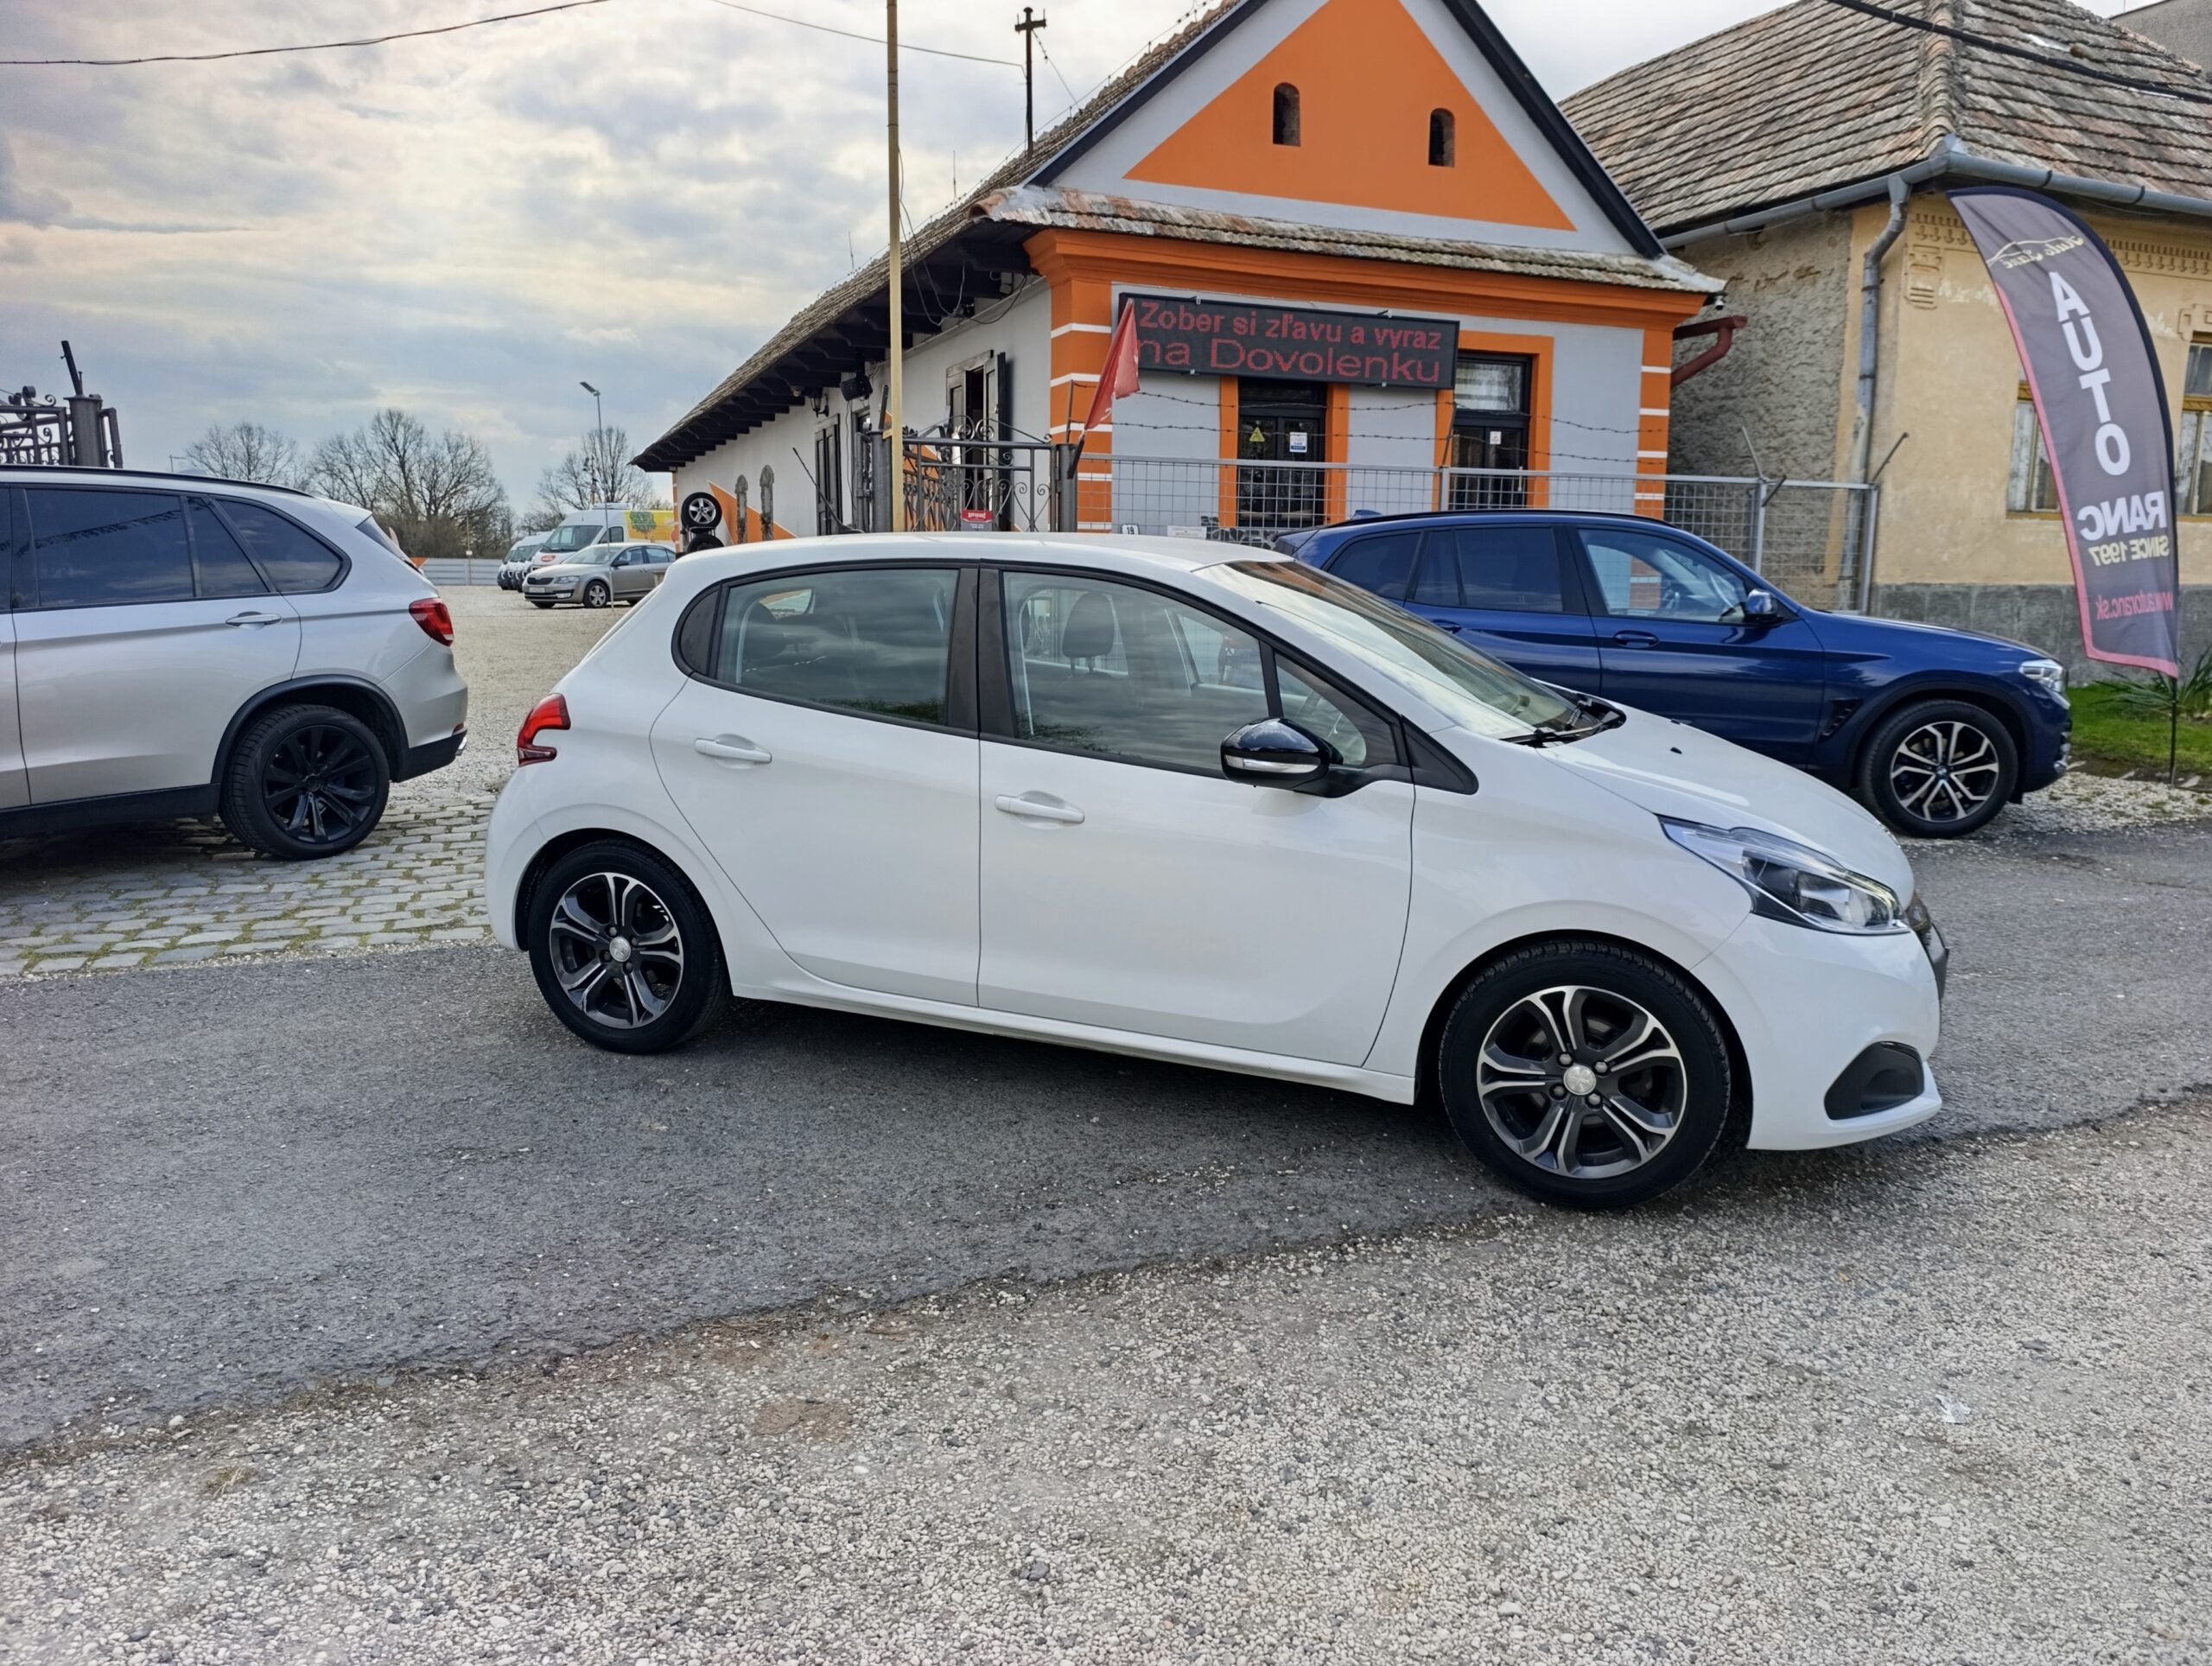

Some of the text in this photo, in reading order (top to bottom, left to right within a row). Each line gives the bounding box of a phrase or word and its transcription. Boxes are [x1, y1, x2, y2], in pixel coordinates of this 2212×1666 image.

[1139, 302, 1443, 350] Zober si zľavu a vyraz
[1138, 338, 1440, 382] na Dovolenku
